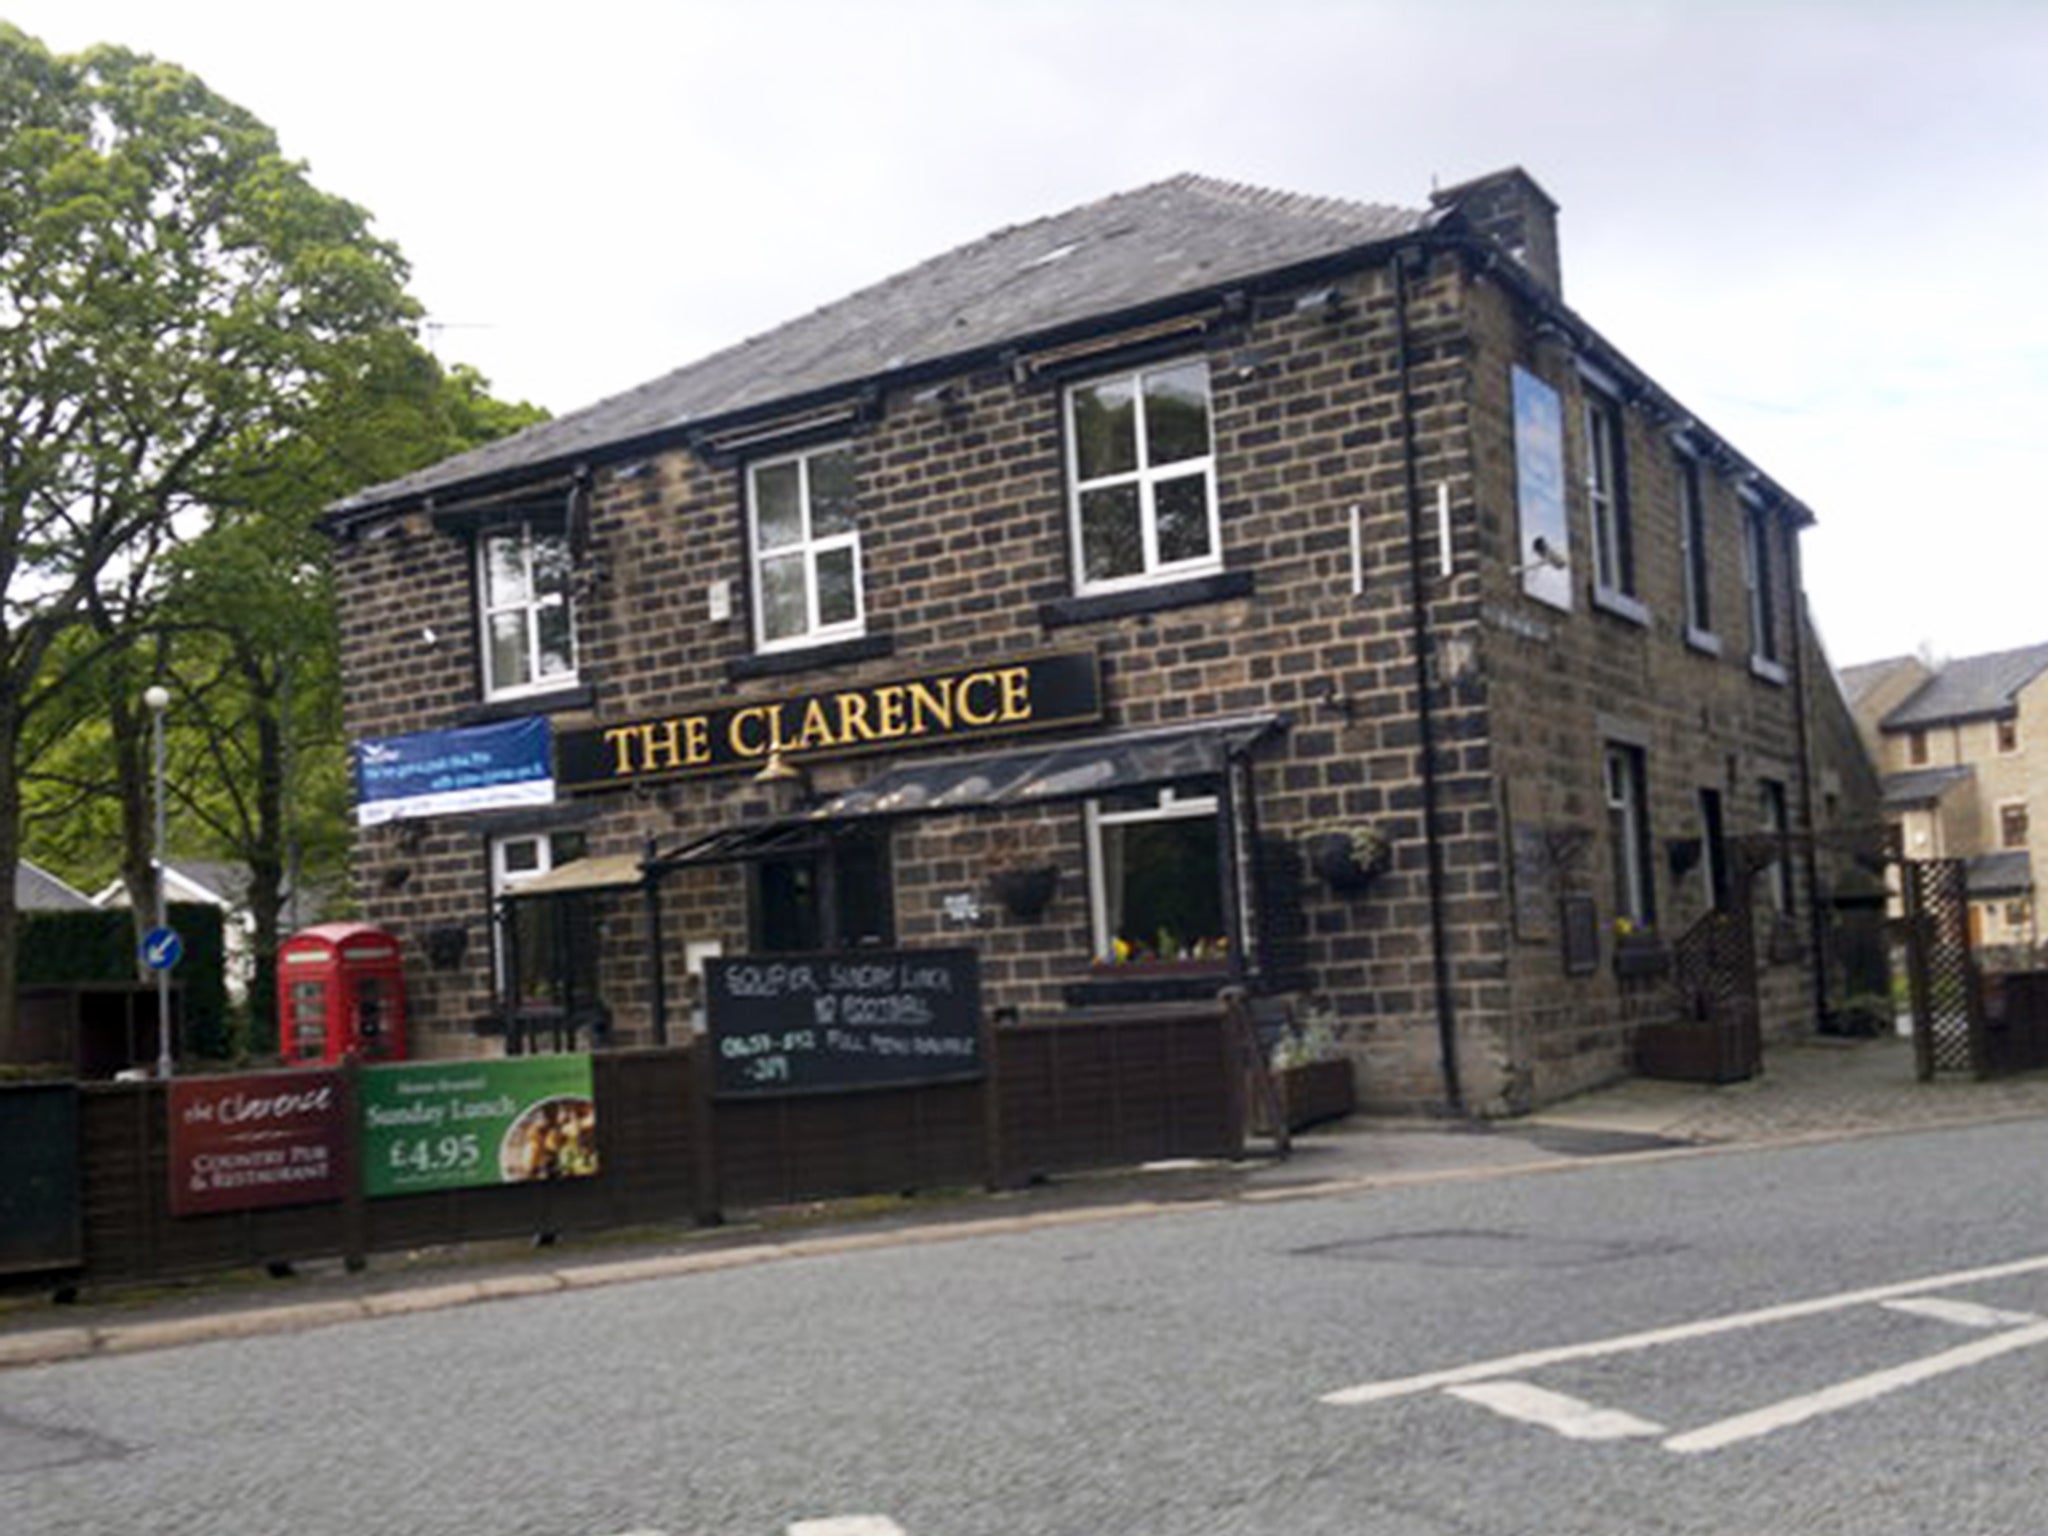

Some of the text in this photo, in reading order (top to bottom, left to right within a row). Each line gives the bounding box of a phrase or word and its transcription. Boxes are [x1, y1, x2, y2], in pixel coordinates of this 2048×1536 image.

[603, 667, 1033, 774] THE CLARENCE
[367, 1095, 517, 1129] Sunday Lunch
[389, 1133, 480, 1171] £4.95
